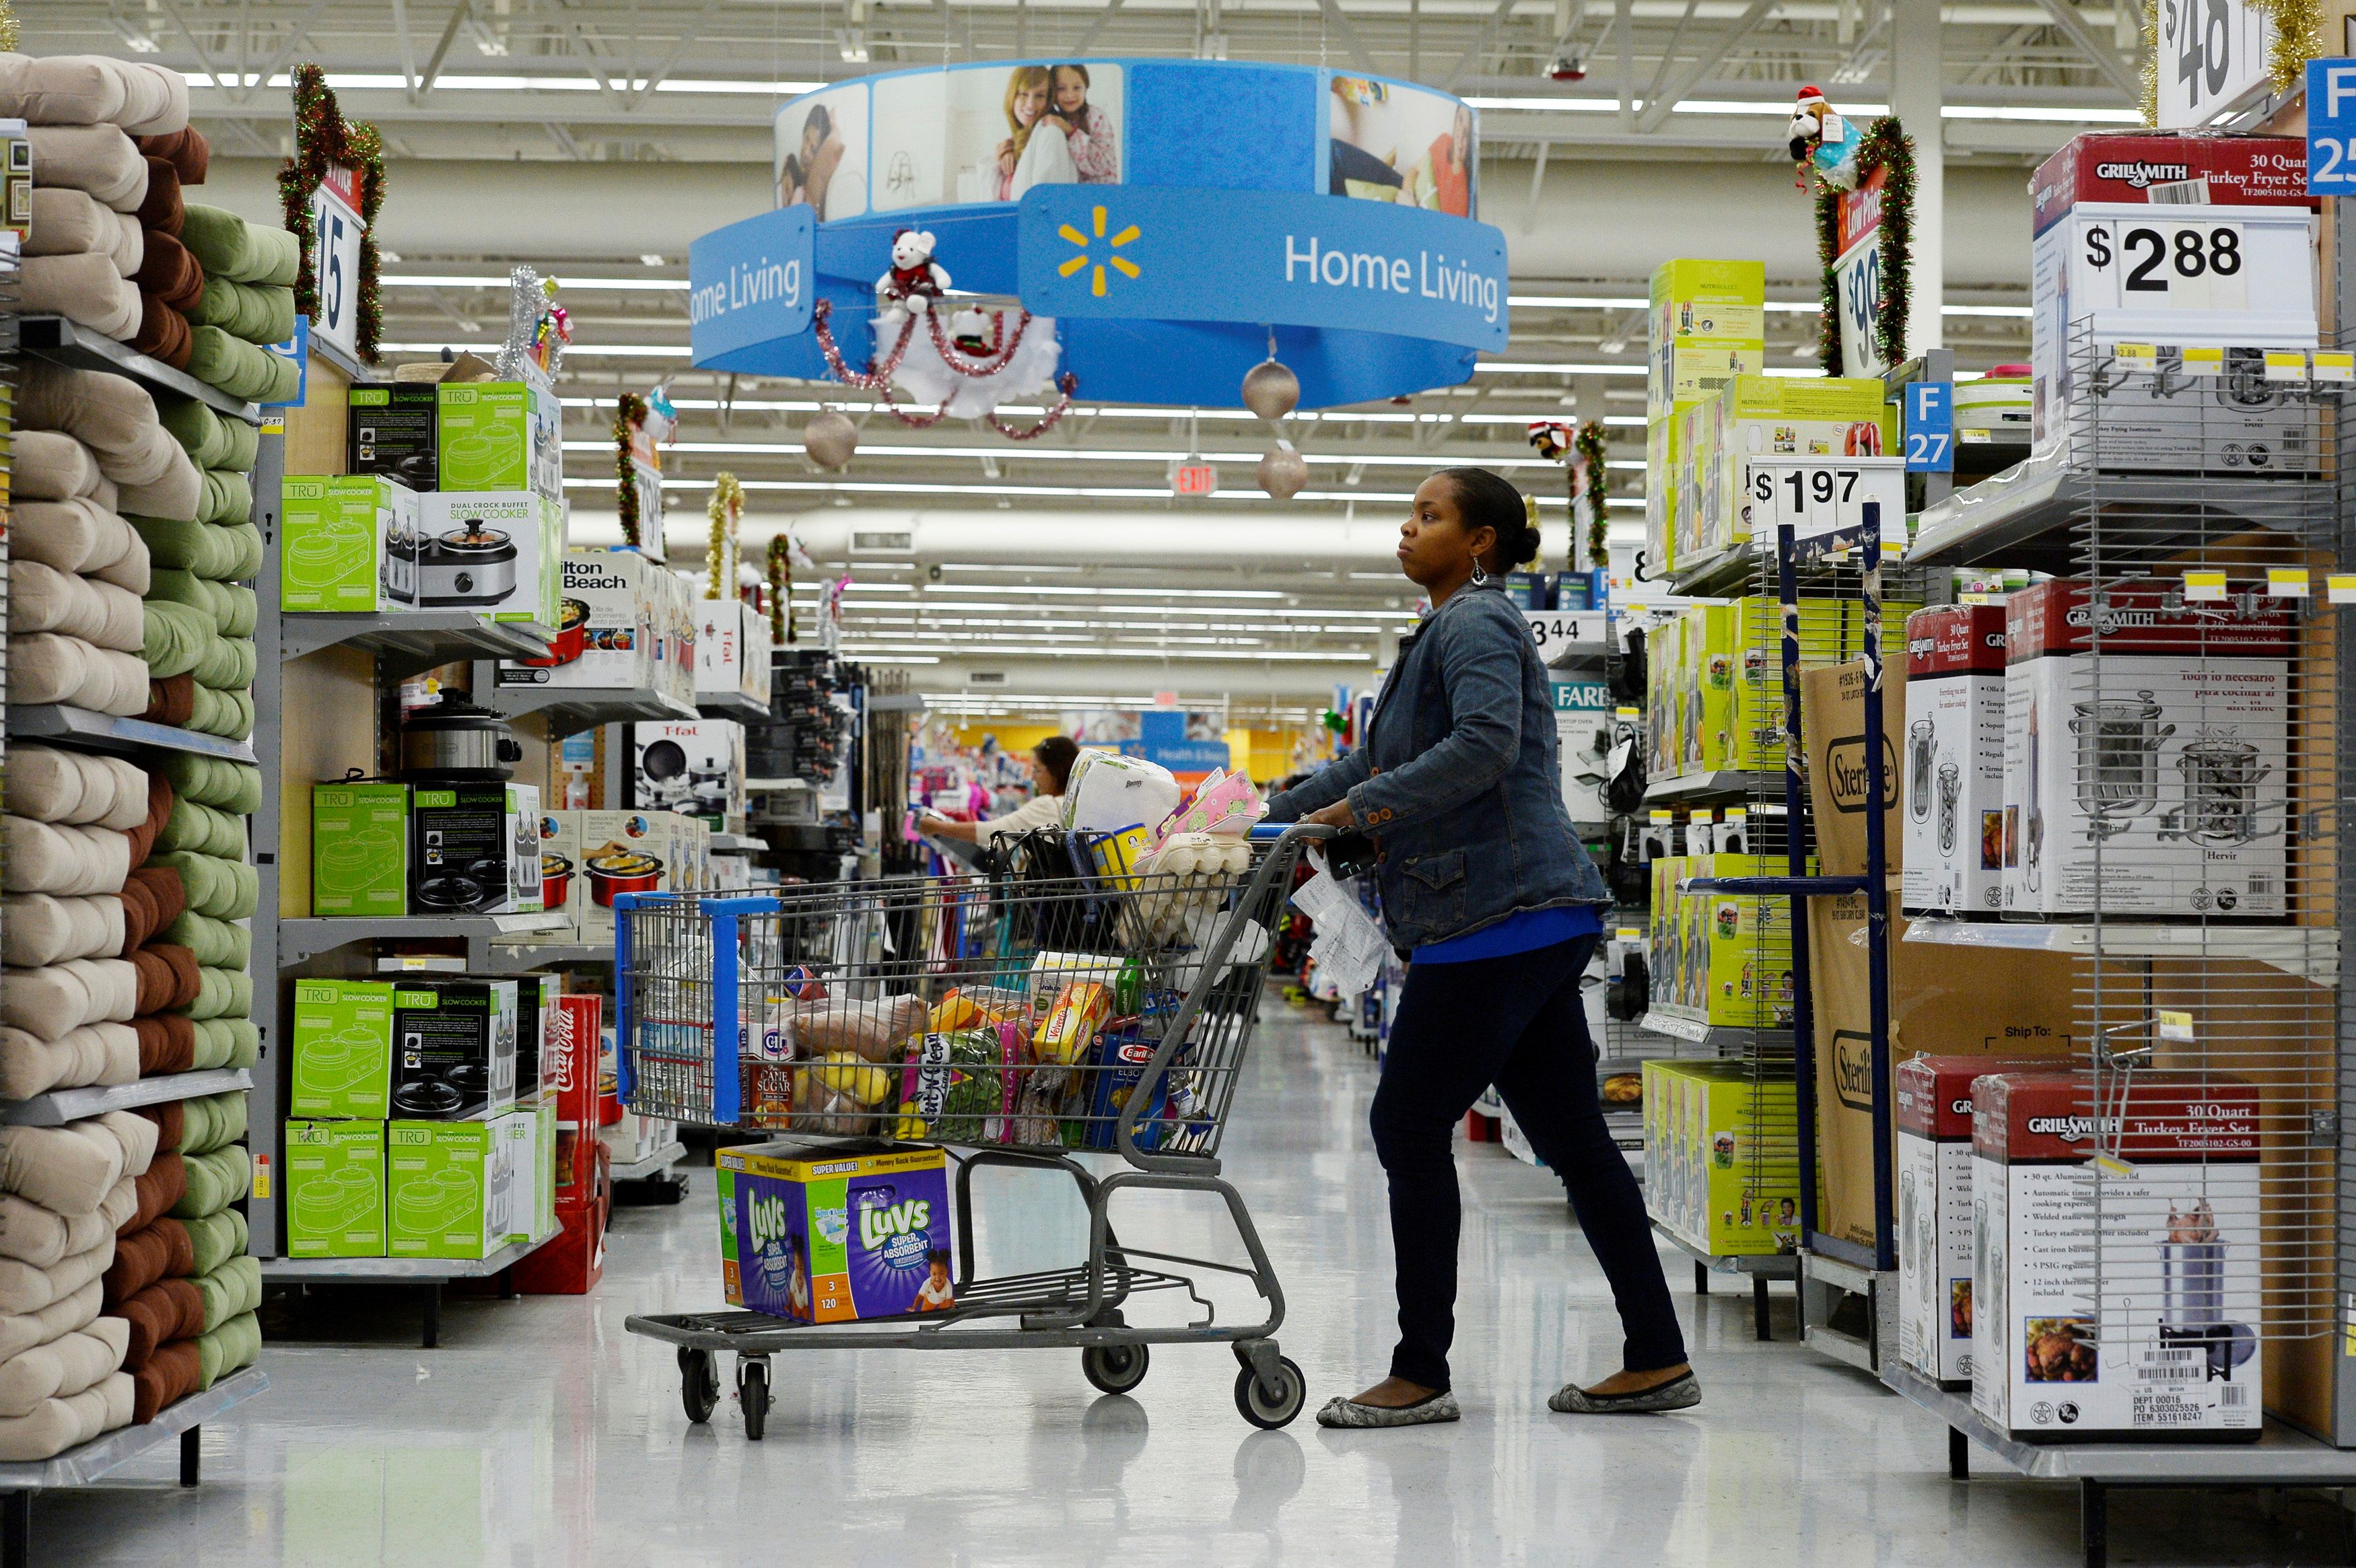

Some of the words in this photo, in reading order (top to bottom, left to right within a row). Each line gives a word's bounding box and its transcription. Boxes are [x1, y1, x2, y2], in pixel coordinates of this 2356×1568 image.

[2250, 155, 2268, 168] 30
[2095, 161, 2188, 188] GRILLSMITH
[2201, 170, 2248, 187] Turkey
[2253, 172, 2289, 187] Fryer
[1847, 205, 1864, 240] Low
[730, 257, 801, 308] Living
[1285, 235, 1412, 294] Home
[1420, 250, 1498, 324] Living
[1919, 388, 1939, 421] F
[1908, 433, 1949, 464] 27
[1179, 466, 1211, 493] EXIT
[450, 509, 484, 520] SLOW
[483, 509, 528, 519] COOKER
[563, 575, 626, 589] Beach
[662, 725, 699, 736] T-fal
[2207, 851, 2237, 861] Hervir
[361, 995, 387, 1003] COOKER
[2005, 1026, 2032, 1038] Ship
[2033, 1026, 2051, 1036] To:
[1118, 1069, 1146, 1077] ELBO
[757, 1081, 791, 1092] SUGAR
[812, 1164, 833, 1176] SUPER
[834, 1162, 859, 1172] VALUE!
[876, 1158, 894, 1167] Money
[895, 1156, 909, 1164] Back
[2042, 1174, 2052, 1182] qt.
[2032, 1200, 2062, 1209] cooking
[891, 1232, 917, 1248] SUPER
[2033, 1230, 2057, 1239] Turkey
[884, 1239, 929, 1259] ABSORBENT
[828, 1281, 835, 1291] 3
[821, 1298, 837, 1309] 120
[2133, 1396, 2153, 1404] DEPT
[2155, 1395, 2180, 1404] 00016
[2133, 1405, 2145, 1413] PO
[2149, 1404, 2200, 1413] 6303025526
[2133, 1413, 2154, 1423] ITEM
[2157, 1412, 2202, 1422] 551618247
